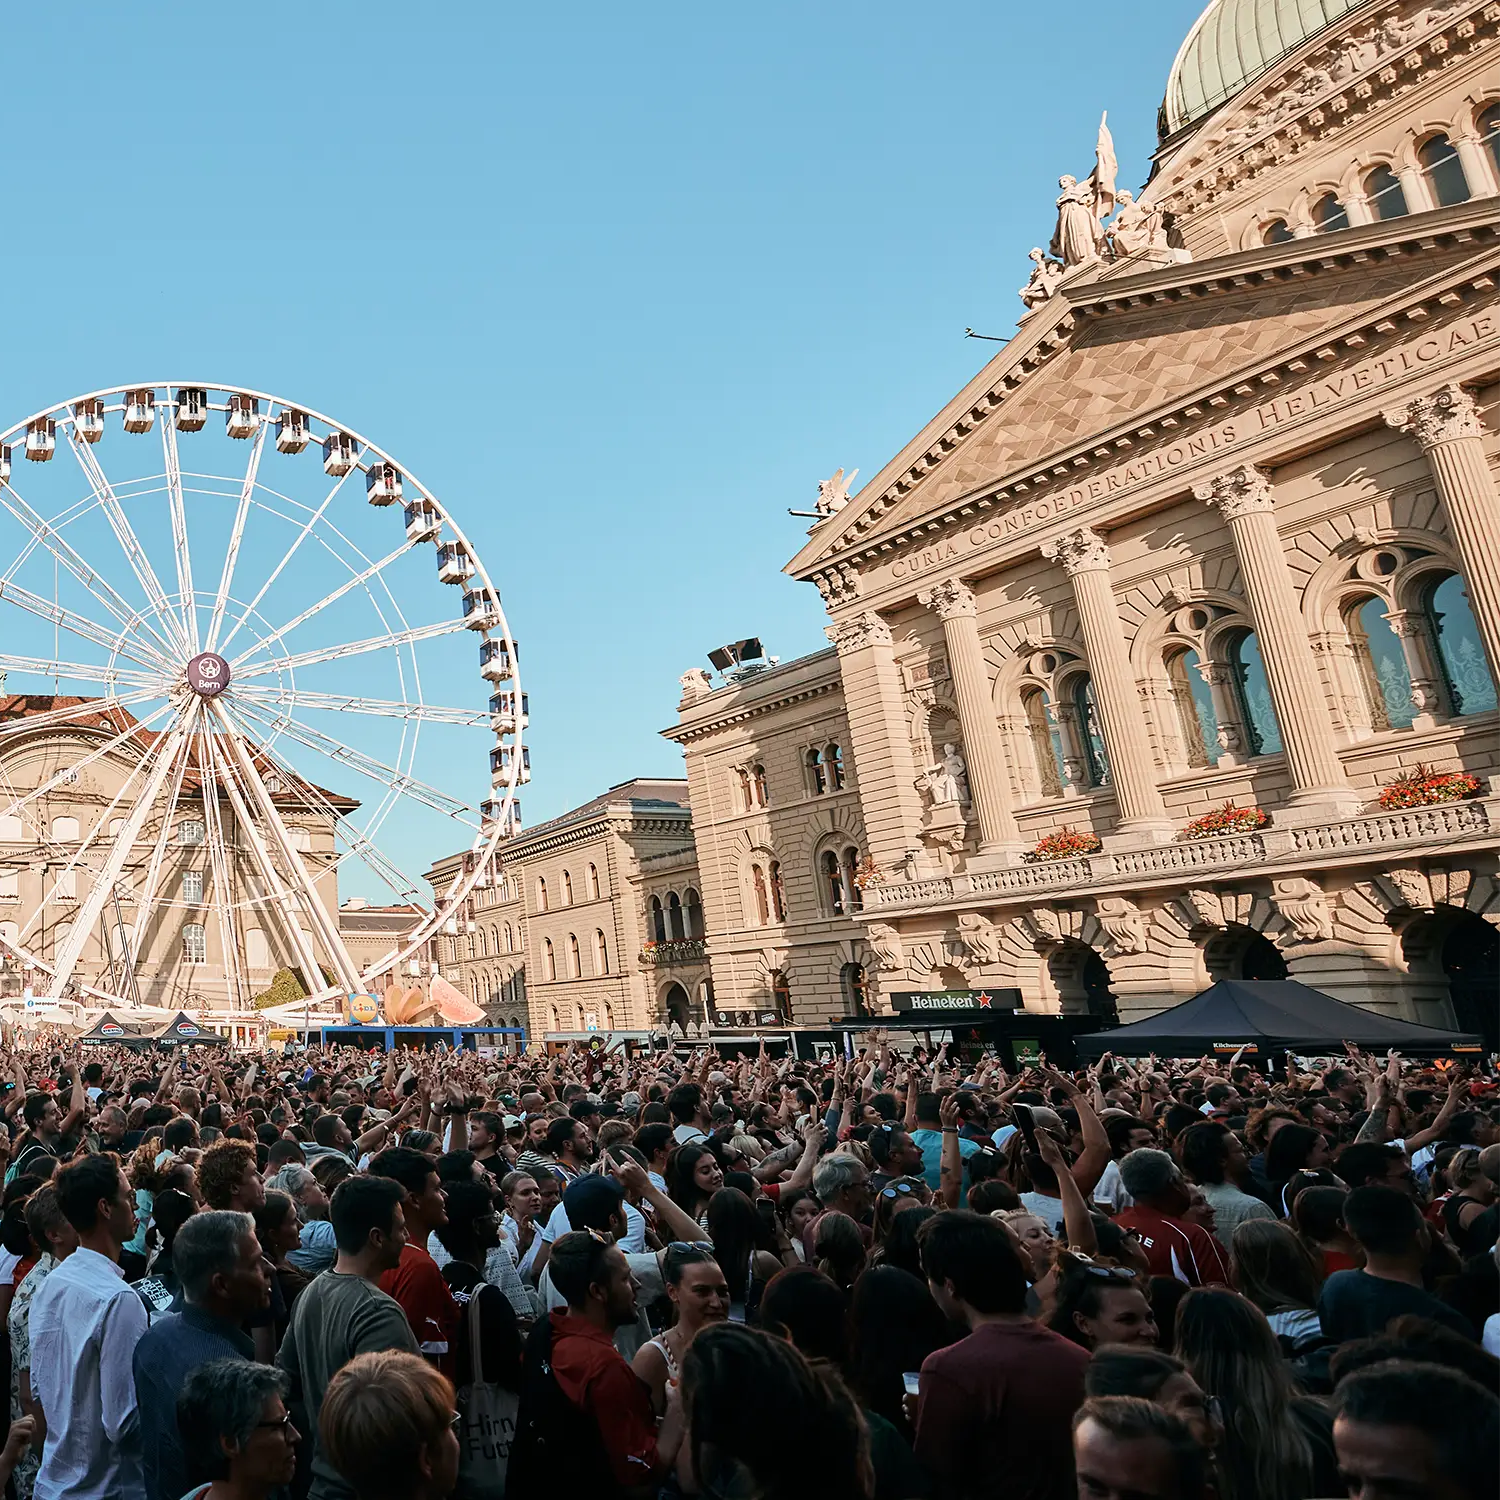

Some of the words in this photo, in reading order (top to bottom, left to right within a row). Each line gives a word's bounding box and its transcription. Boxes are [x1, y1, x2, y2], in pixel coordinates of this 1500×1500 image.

[891, 543, 959, 578] CURIA
[969, 426, 1236, 546] CONFOEDERATIONIS
[1256, 317, 1497, 430] HELVETICAE
[198, 680, 221, 689] Bern
[909, 993, 974, 1010] Heineken
[154, 1279, 170, 1297] THE
[466, 1413, 515, 1437] Hirn
